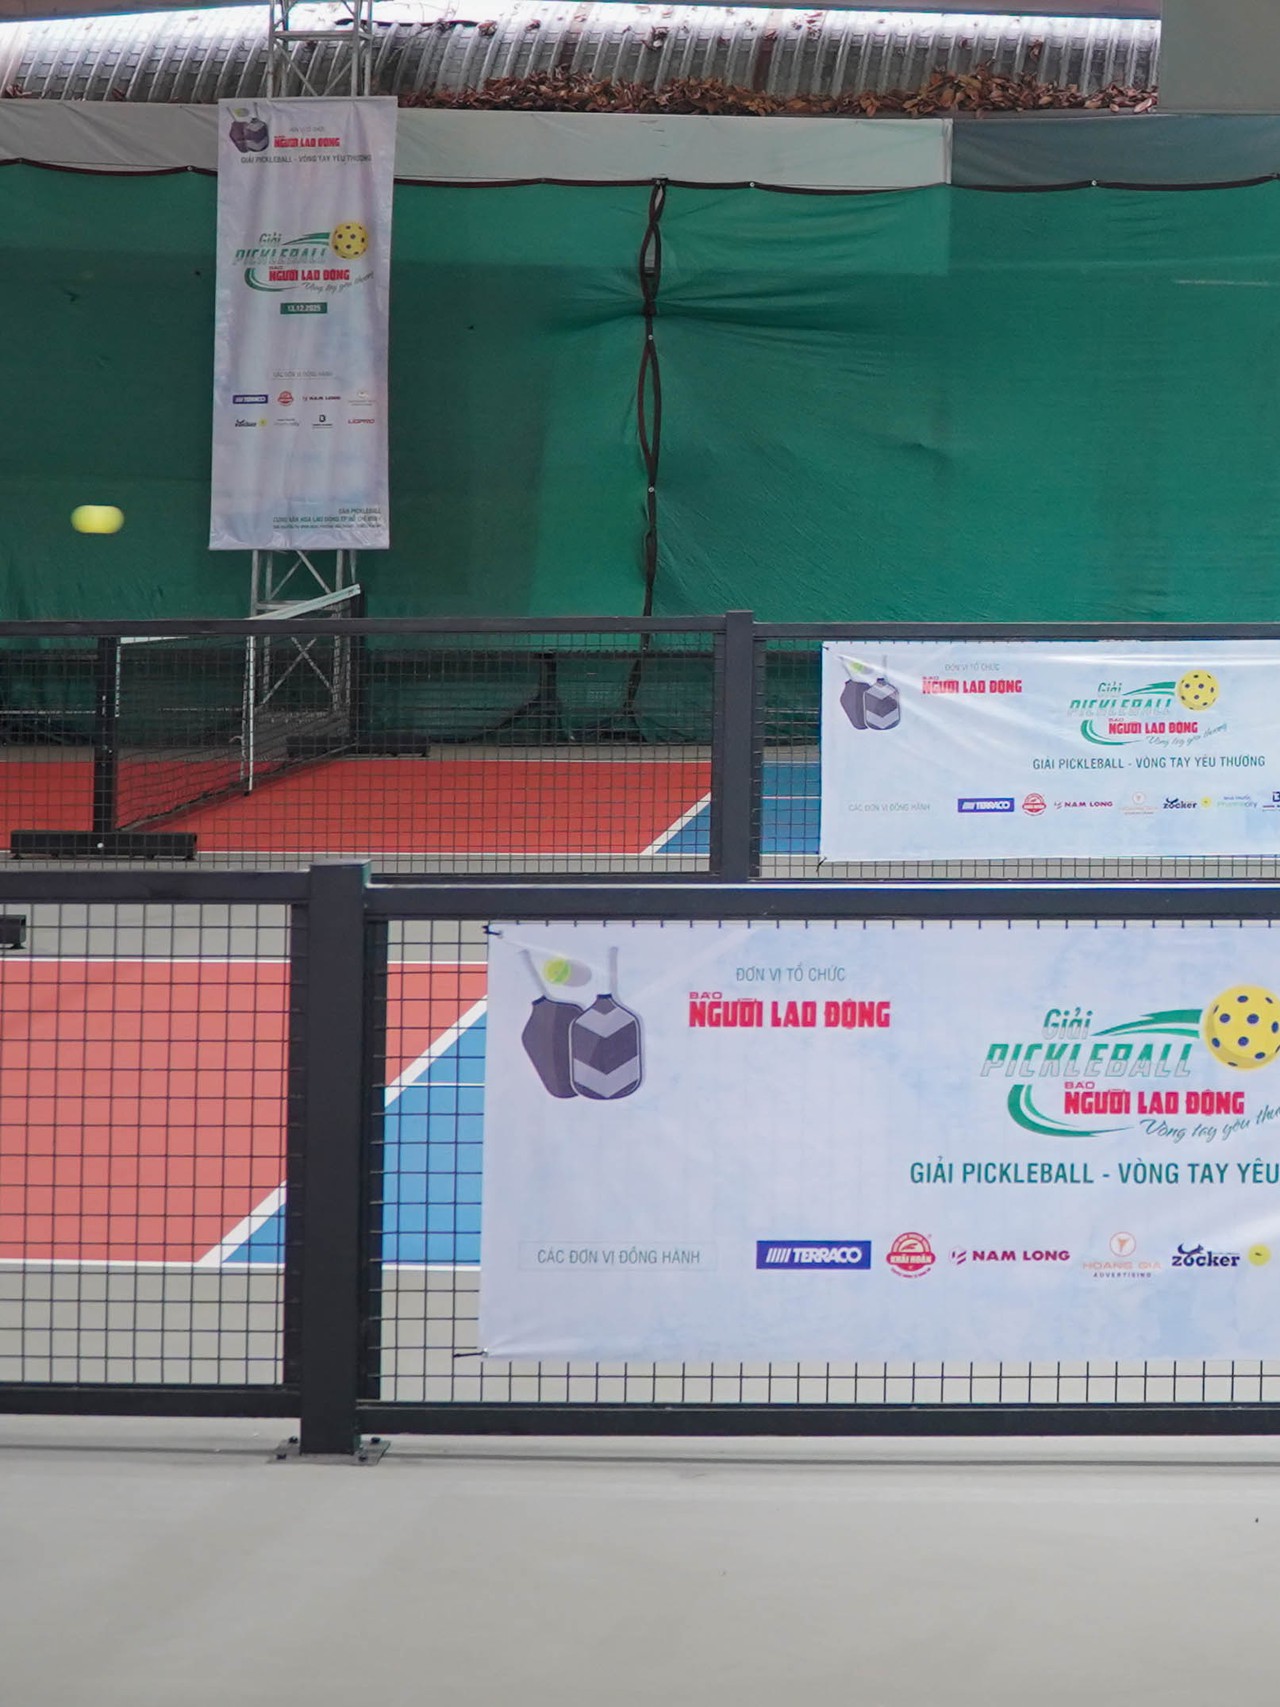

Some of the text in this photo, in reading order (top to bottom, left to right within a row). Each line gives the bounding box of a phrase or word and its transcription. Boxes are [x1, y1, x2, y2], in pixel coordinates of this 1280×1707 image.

[302, 270, 320, 281] LAO
[963, 680, 986, 694] LAO
[1145, 722, 1165, 734] LAO
[1058, 758, 1124, 769] PICKLEBALL
[1136, 755, 1166, 768] VÒNG
[1170, 756, 1191, 768] TAY
[1194, 753, 1216, 768] YÊU
[1220, 754, 1265, 767] THƯƠNG
[736, 962, 845, 984] ĐƠN VỊ TỔ CHỨC
[771, 1001, 817, 1028] LAO
[824, 998, 891, 1030] ĐỘNG
[1041, 1006, 1093, 1040] Giải
[980, 1043, 1193, 1078] PICKLEBALL
[1137, 1091, 1179, 1115] LAO
[1186, 1088, 1245, 1117] ĐỘNG
[910, 1155, 954, 1184] GIẢI
[962, 1161, 1095, 1184] PICKLEBALL
[1118, 1156, 1179, 1184] VÒNG
[1188, 1161, 1229, 1184] TAY
[1237, 1158, 1280, 1184] YÊU
[537, 1244, 700, 1266] CÁC ĐƠN VỊ ĐỒNG HÀNH
[792, 1248, 862, 1264] TERRACO
[973, 1250, 1070, 1262] NAM LONG
[1172, 1245, 1240, 1267] zocker
